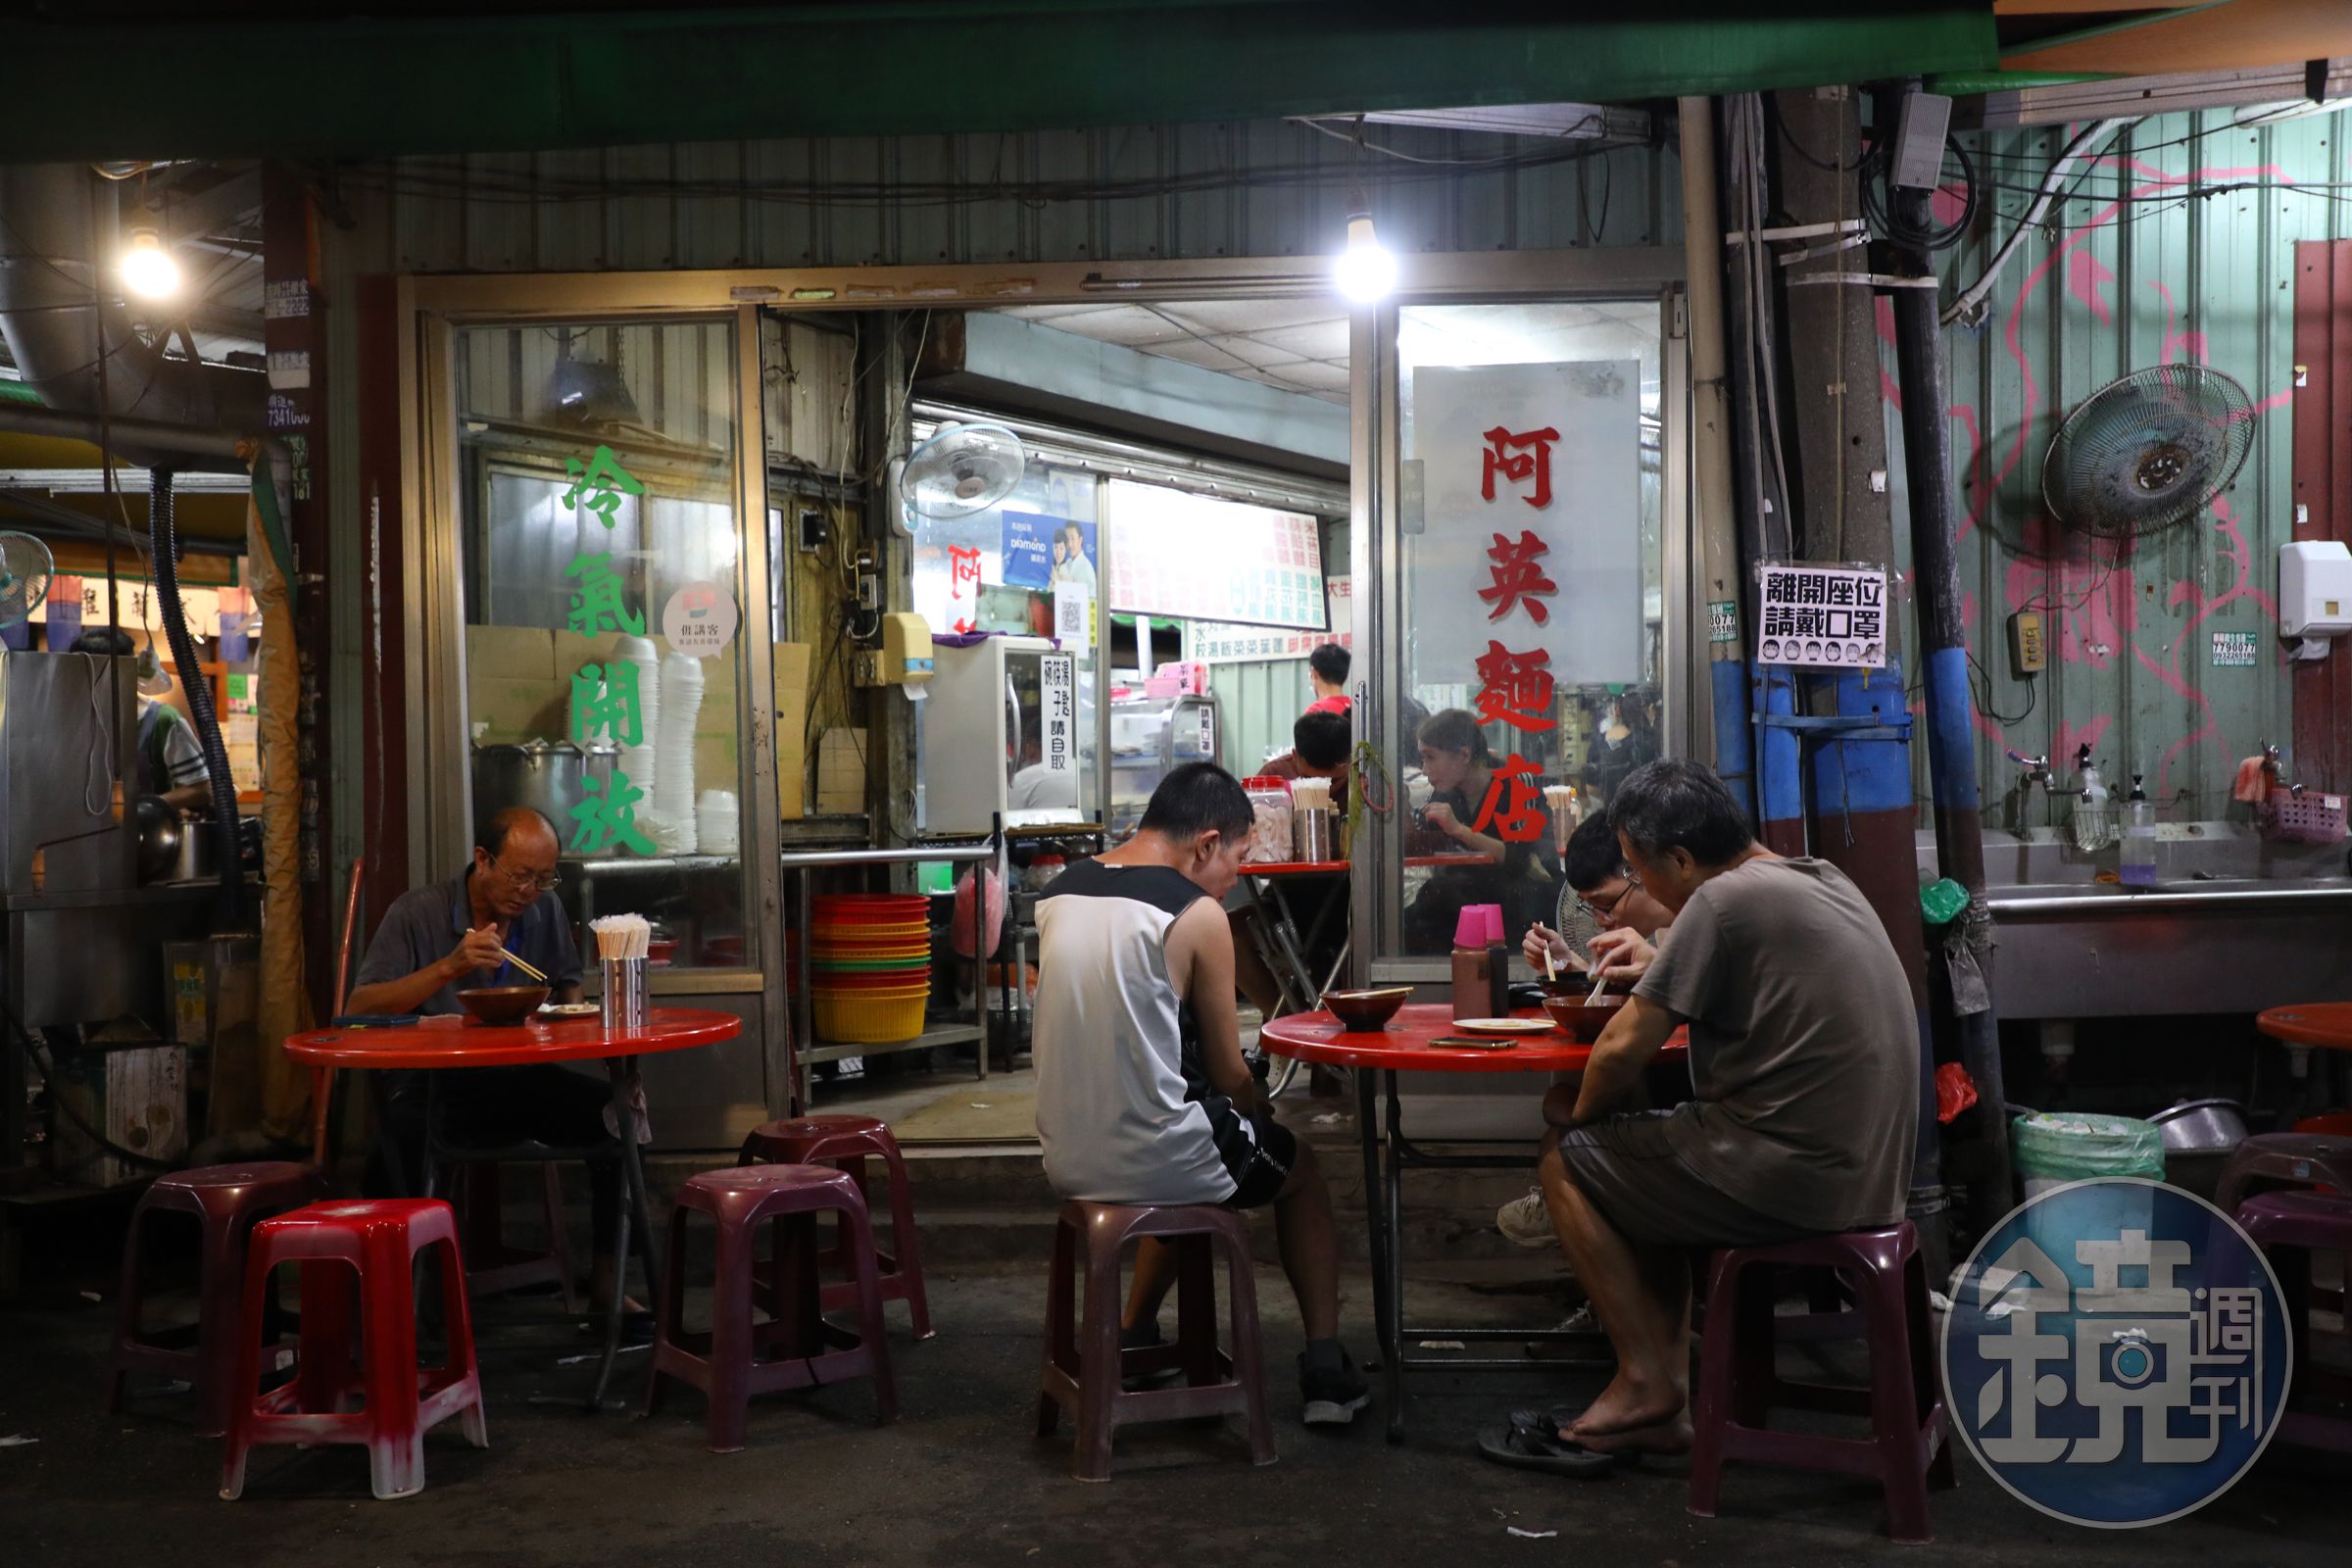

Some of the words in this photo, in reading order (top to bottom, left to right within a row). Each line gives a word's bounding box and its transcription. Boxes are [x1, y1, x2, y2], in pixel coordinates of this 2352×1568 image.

[1766, 572, 1882, 608] 離開座位
[1472, 426, 1560, 843] 阿英麵店
[1764, 606, 1881, 639] 請戴口罩
[562, 445, 658, 856] 冷氣開放
[2213, 643, 2255, 652] 7790077
